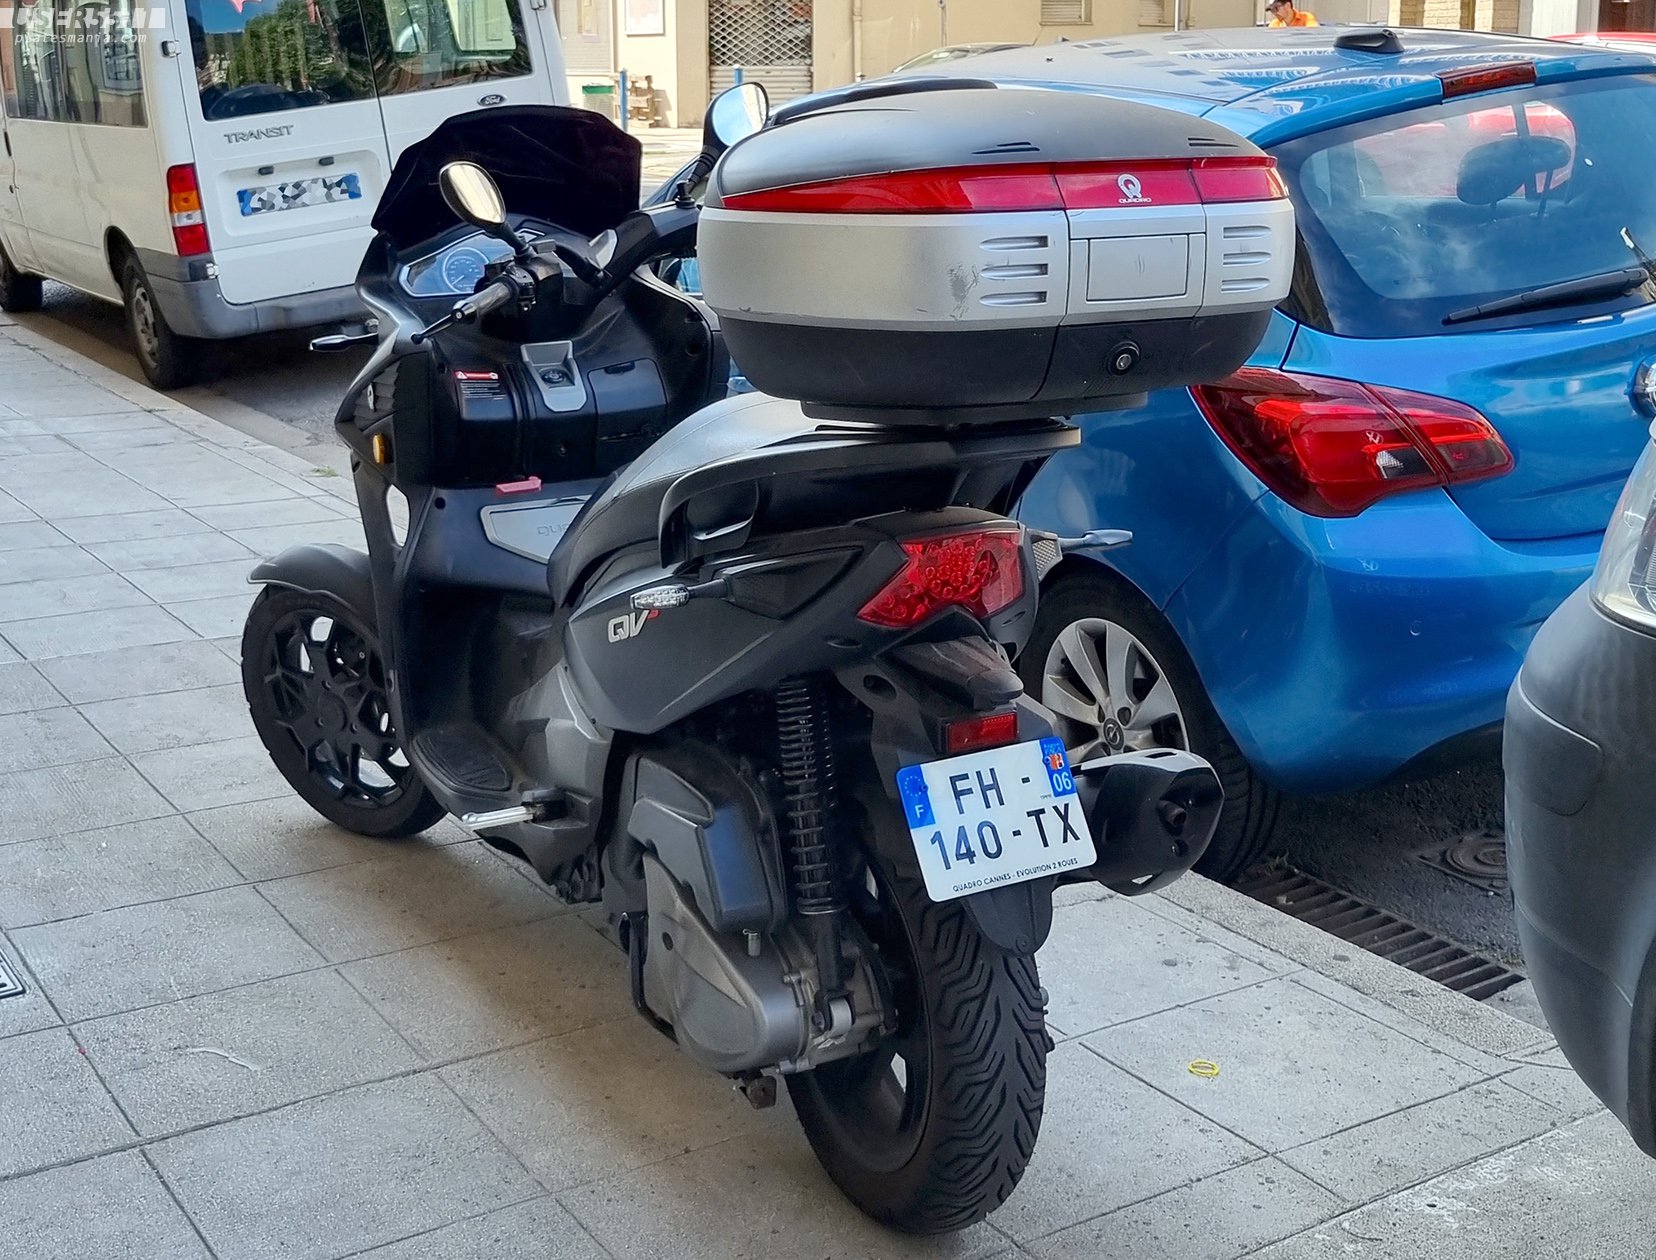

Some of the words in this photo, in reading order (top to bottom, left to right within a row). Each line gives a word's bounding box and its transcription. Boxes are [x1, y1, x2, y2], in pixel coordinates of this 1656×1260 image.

[223, 124, 295, 144] TRANSIT
[1052, 771, 1072, 792] 06
[914, 804, 925, 819] F
[952, 879, 983, 892] QUADRO
[983, 872, 1012, 885] CANNES
[1016, 863, 1052, 878] EVOLUTION
[1052, 862, 1057, 870] 2
[1057, 857, 1079, 869] ROUES
